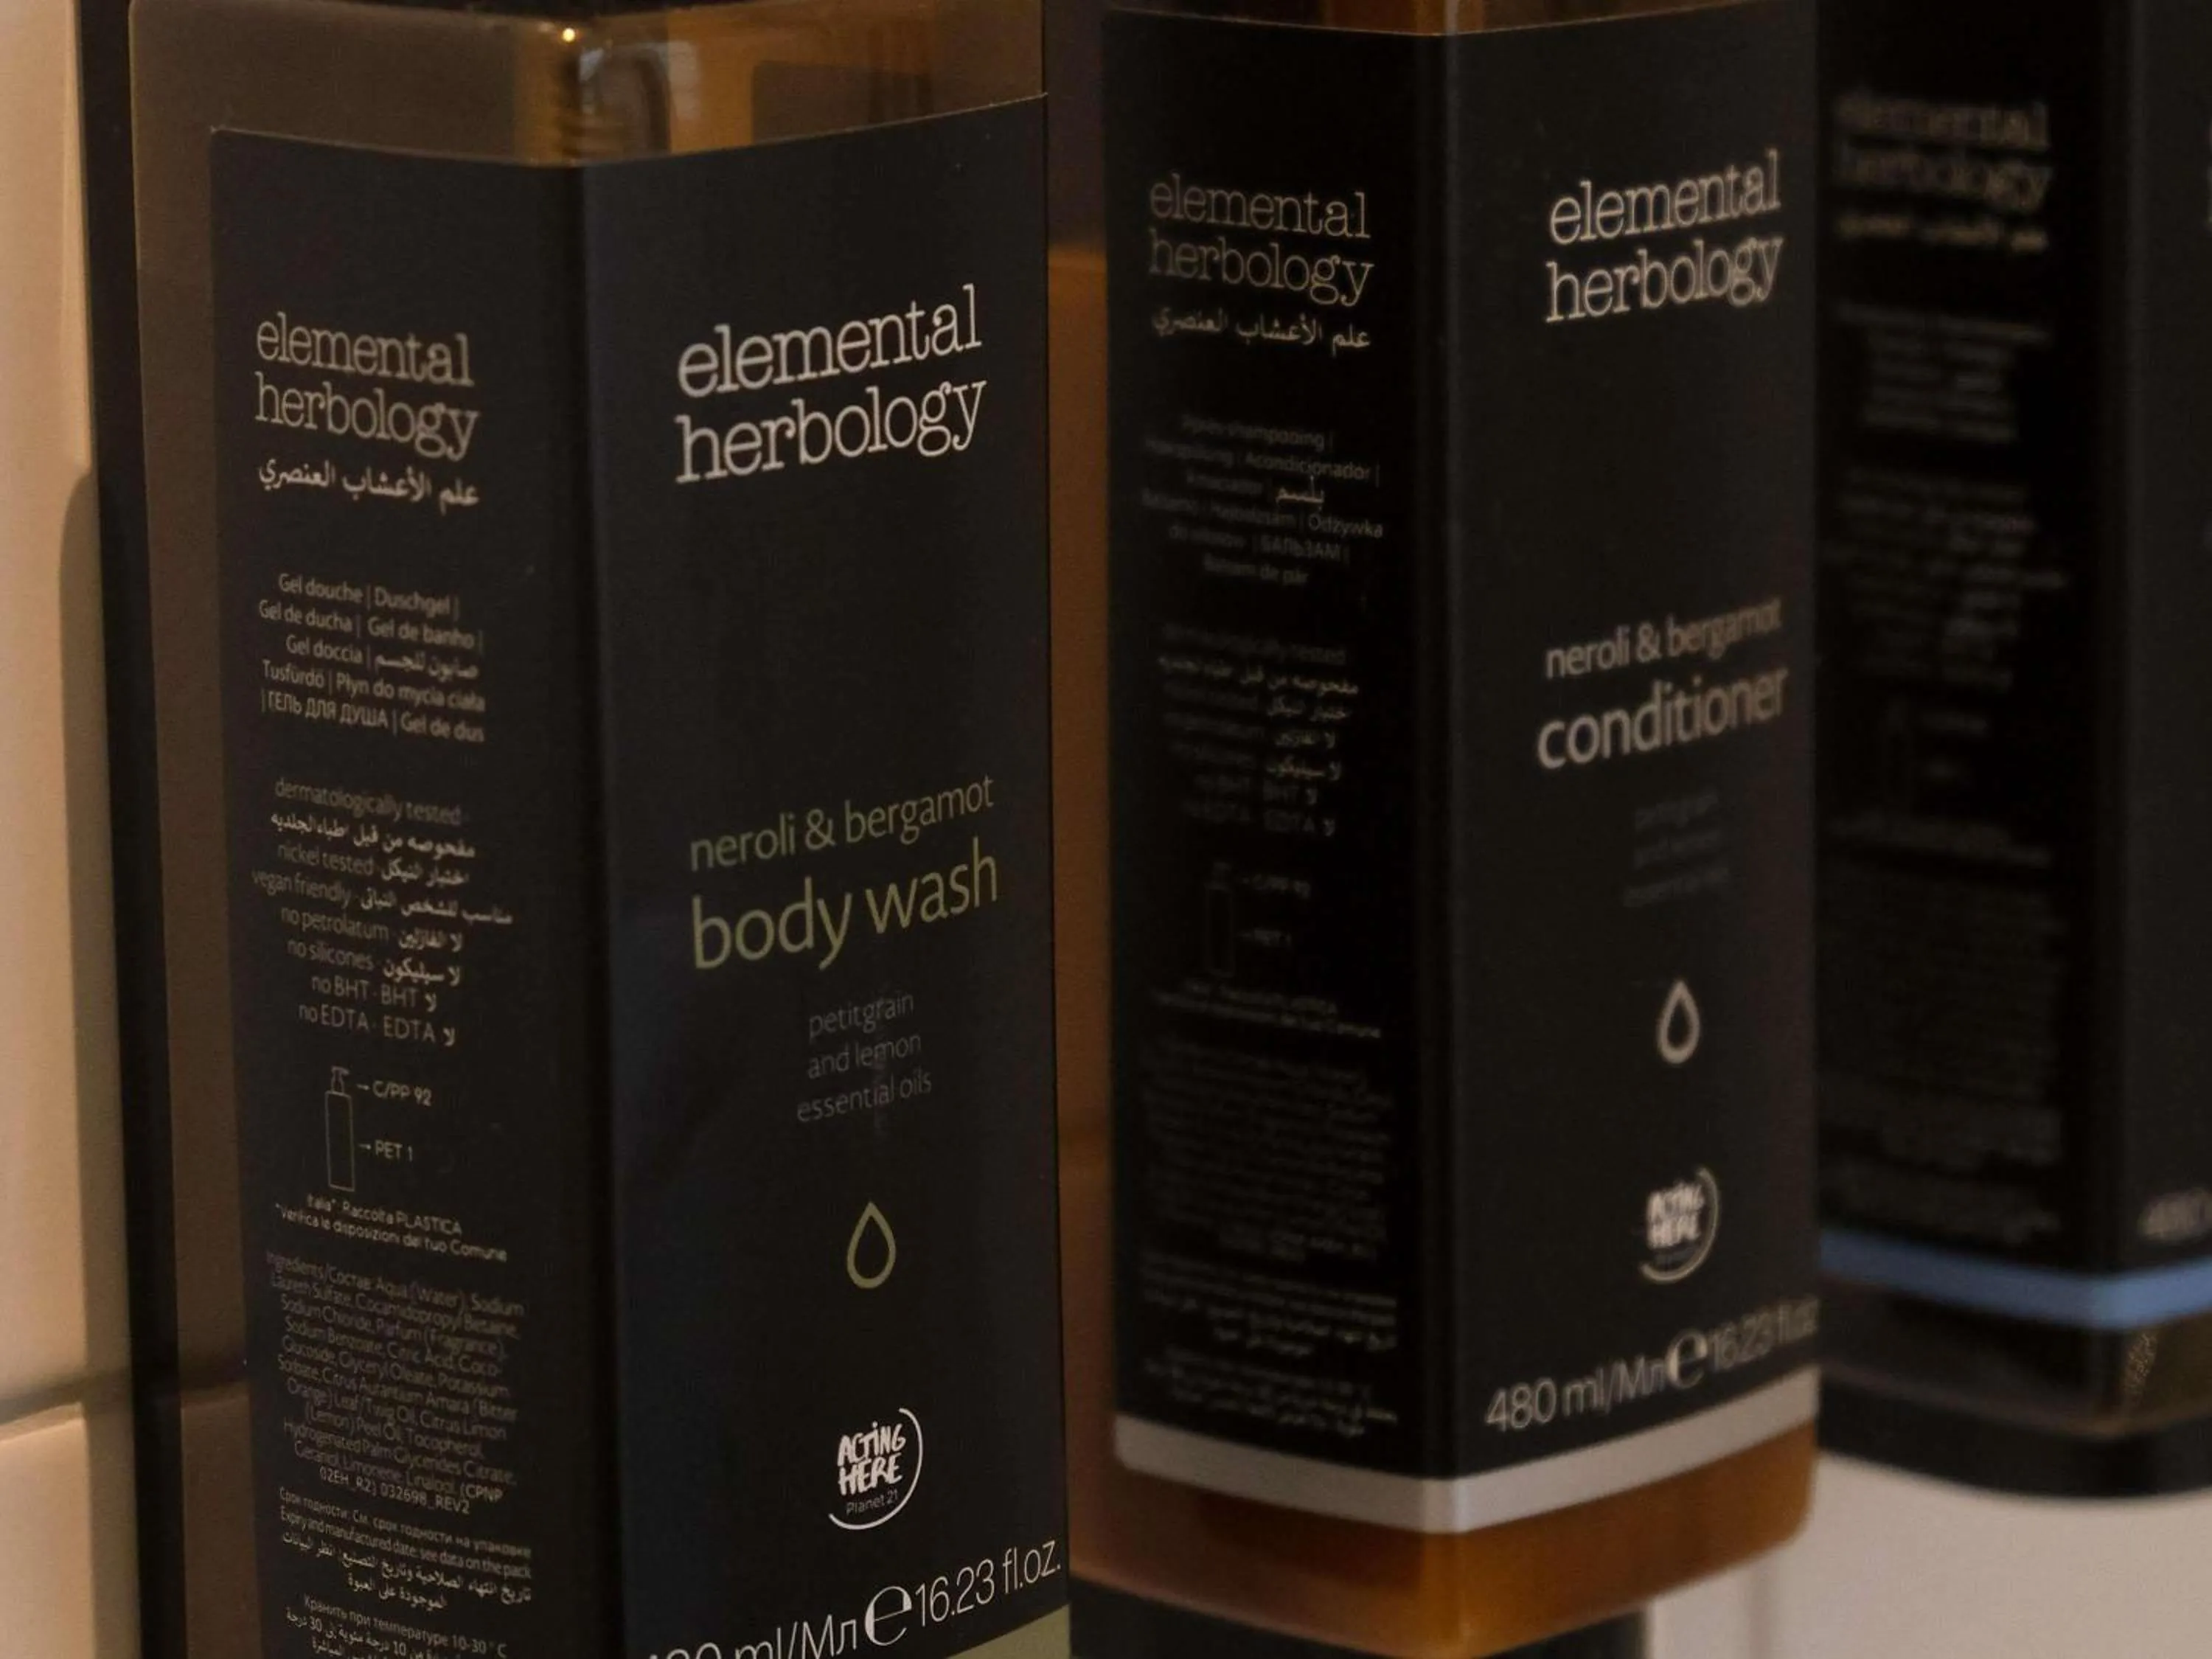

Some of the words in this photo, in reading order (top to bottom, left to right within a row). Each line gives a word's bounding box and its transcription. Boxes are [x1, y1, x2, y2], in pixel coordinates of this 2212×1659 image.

[1150, 172, 1371, 238] elemental
[1550, 147, 1781, 246] elemental
[1148, 226, 1374, 307] herbology
[1544, 235, 1785, 324] herbology
[257, 310, 475, 388] elemental
[677, 282, 983, 399] elemental
[254, 370, 479, 462] herbology
[674, 380, 987, 484] herbology
[439, 478, 480, 516] علم
[278, 573, 303, 594] Gel
[305, 577, 364, 604] douche
[375, 586, 451, 619] Duschgel
[259, 599, 282, 620] Gel
[283, 603, 302, 625] de
[305, 608, 353, 633] ducha
[367, 616, 394, 638] Gel
[397, 622, 419, 641] de
[285, 633, 310, 655] Gel
[313, 639, 364, 664] doccia
[1545, 625, 1630, 680] neroli
[1636, 621, 1661, 663] &
[372, 678, 395, 700] do
[400, 712, 427, 734] Gel
[429, 717, 451, 740] de
[1537, 666, 1789, 770] conditioner
[275, 776, 403, 822] dermatologically
[690, 811, 796, 872] neroli
[804, 807, 836, 851] &
[845, 773, 994, 846] bergamot
[322, 852, 374, 876] tested
[281, 906, 299, 926] no
[692, 875, 853, 971] body
[865, 835, 998, 935] wash
[287, 939, 307, 958] no
[312, 975, 331, 994] no
[334, 975, 370, 999] BHT
[380, 984, 418, 1008] BHT
[299, 1004, 319, 1023] no
[321, 1004, 369, 1031] EDTA
[383, 1015, 436, 1043] EDTA
[809, 992, 914, 1043] petitgrain
[807, 1042, 849, 1079] and
[855, 1034, 921, 1068] lemon
[796, 1074, 895, 1122] essential
[900, 1066, 932, 1099] oils
[375, 1139, 403, 1160] PET
[396, 1210, 462, 1236] PLASTICA
[1485, 1377, 1557, 1432] 480
[838, 1452, 903, 1496] HERE
[846, 1494, 885, 1516] Planet
[914, 1558, 994, 1627] 16.23
